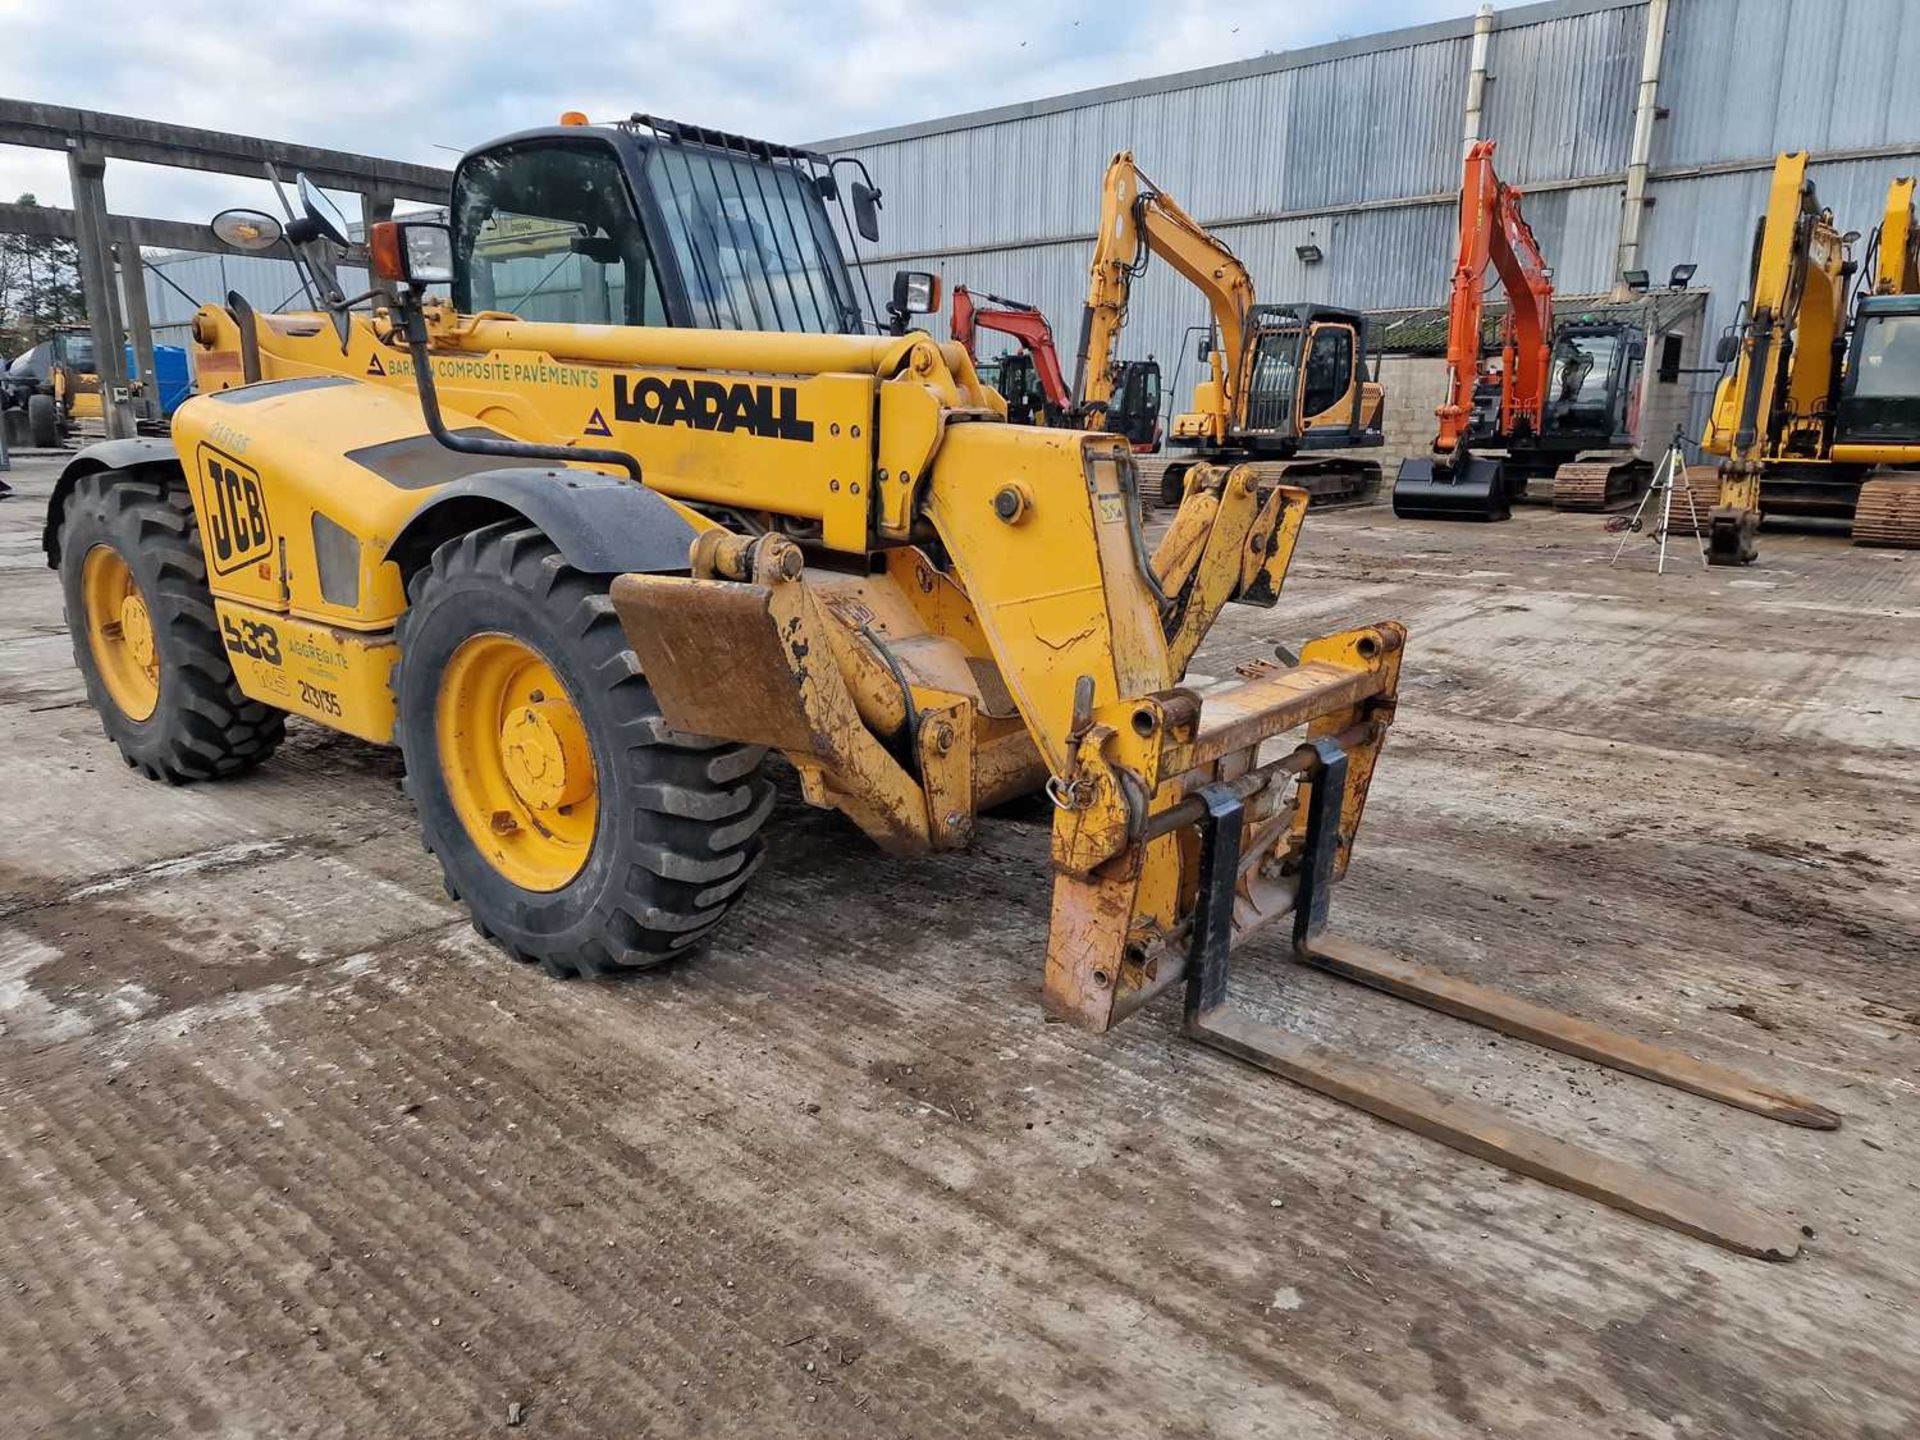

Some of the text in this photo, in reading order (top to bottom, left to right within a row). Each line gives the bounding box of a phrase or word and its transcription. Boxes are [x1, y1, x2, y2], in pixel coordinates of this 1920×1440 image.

[439, 360, 510, 381] COMPOSITE
[514, 365, 599, 388] PAVEMENTS
[614, 374, 814, 442] LOADALL
[208, 458, 266, 561] JCB
